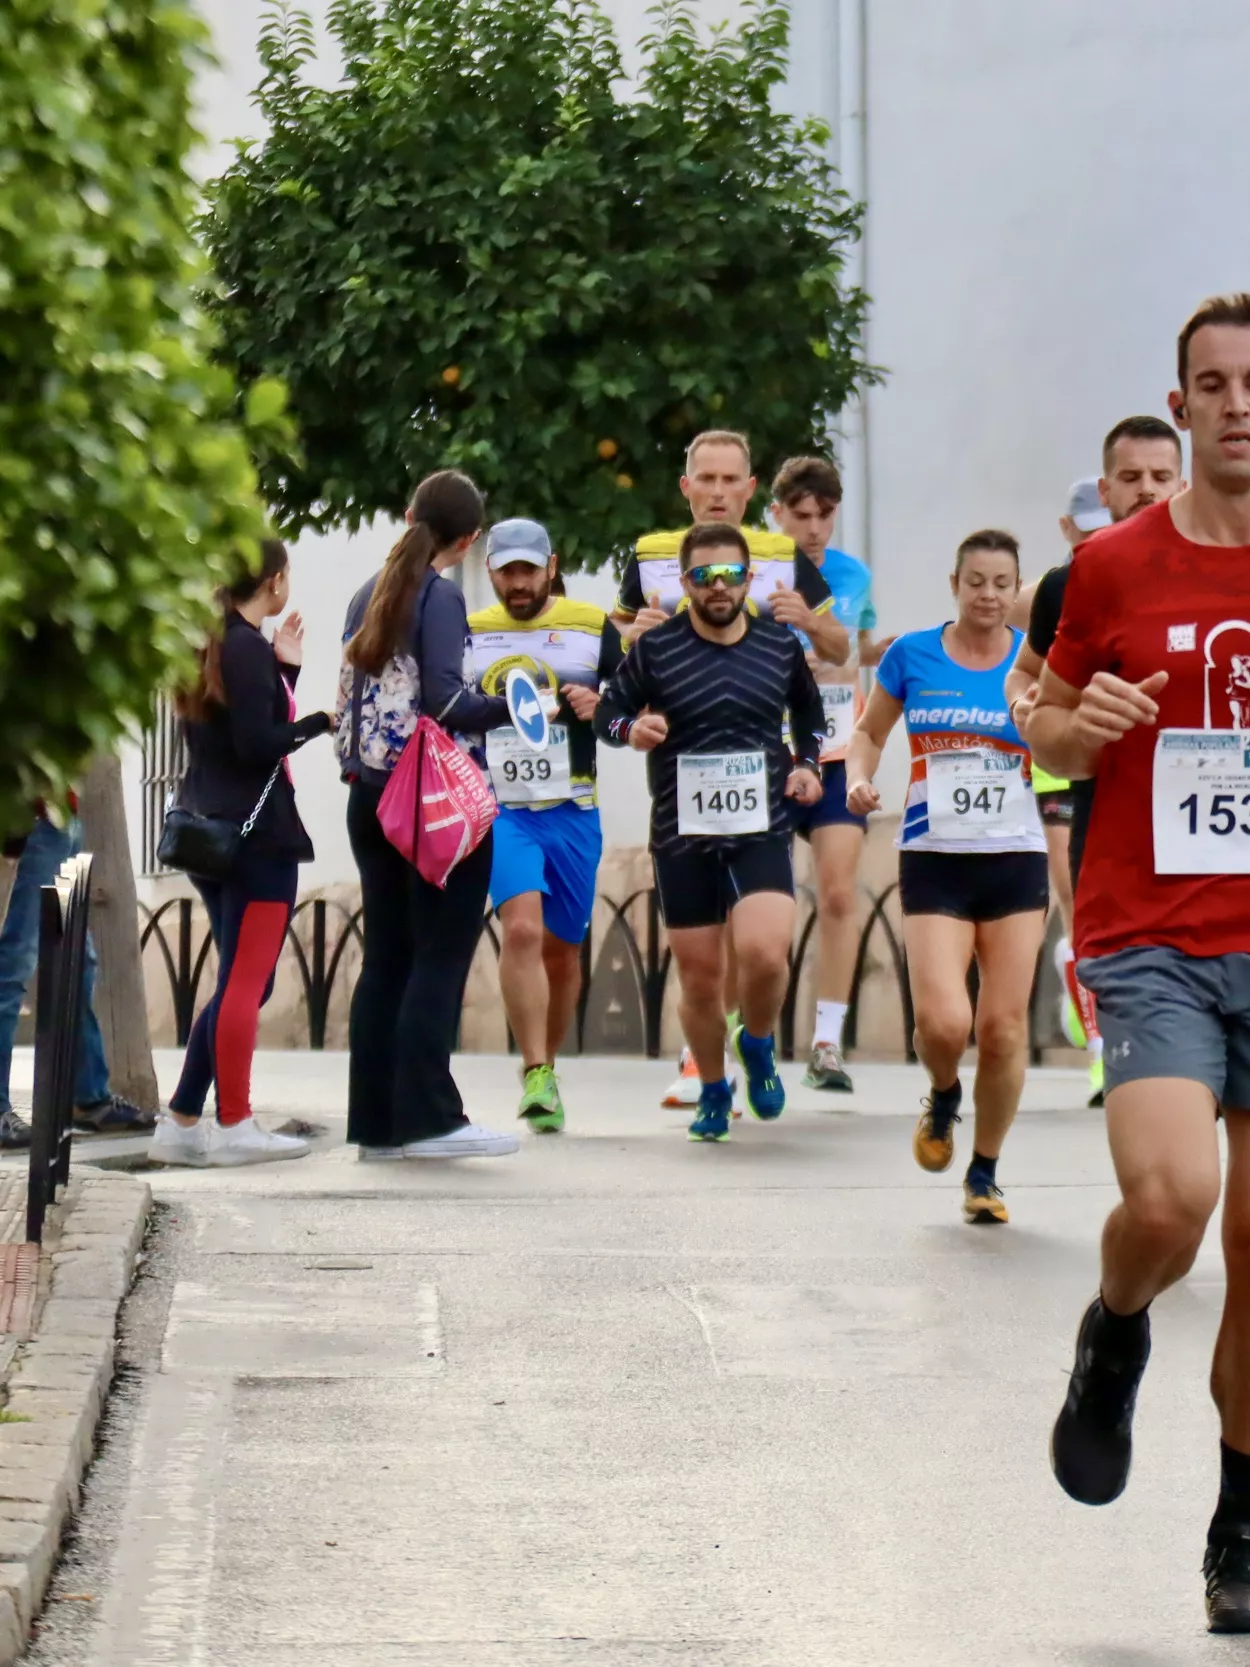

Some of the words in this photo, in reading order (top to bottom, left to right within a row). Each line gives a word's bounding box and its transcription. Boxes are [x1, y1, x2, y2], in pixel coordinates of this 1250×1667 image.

[909, 708, 1007, 727] enerplus
[918, 735, 994, 753] Maratón
[503, 759, 551, 782] 939
[692, 788, 757, 815] 1405
[953, 787, 1006, 815] 947
